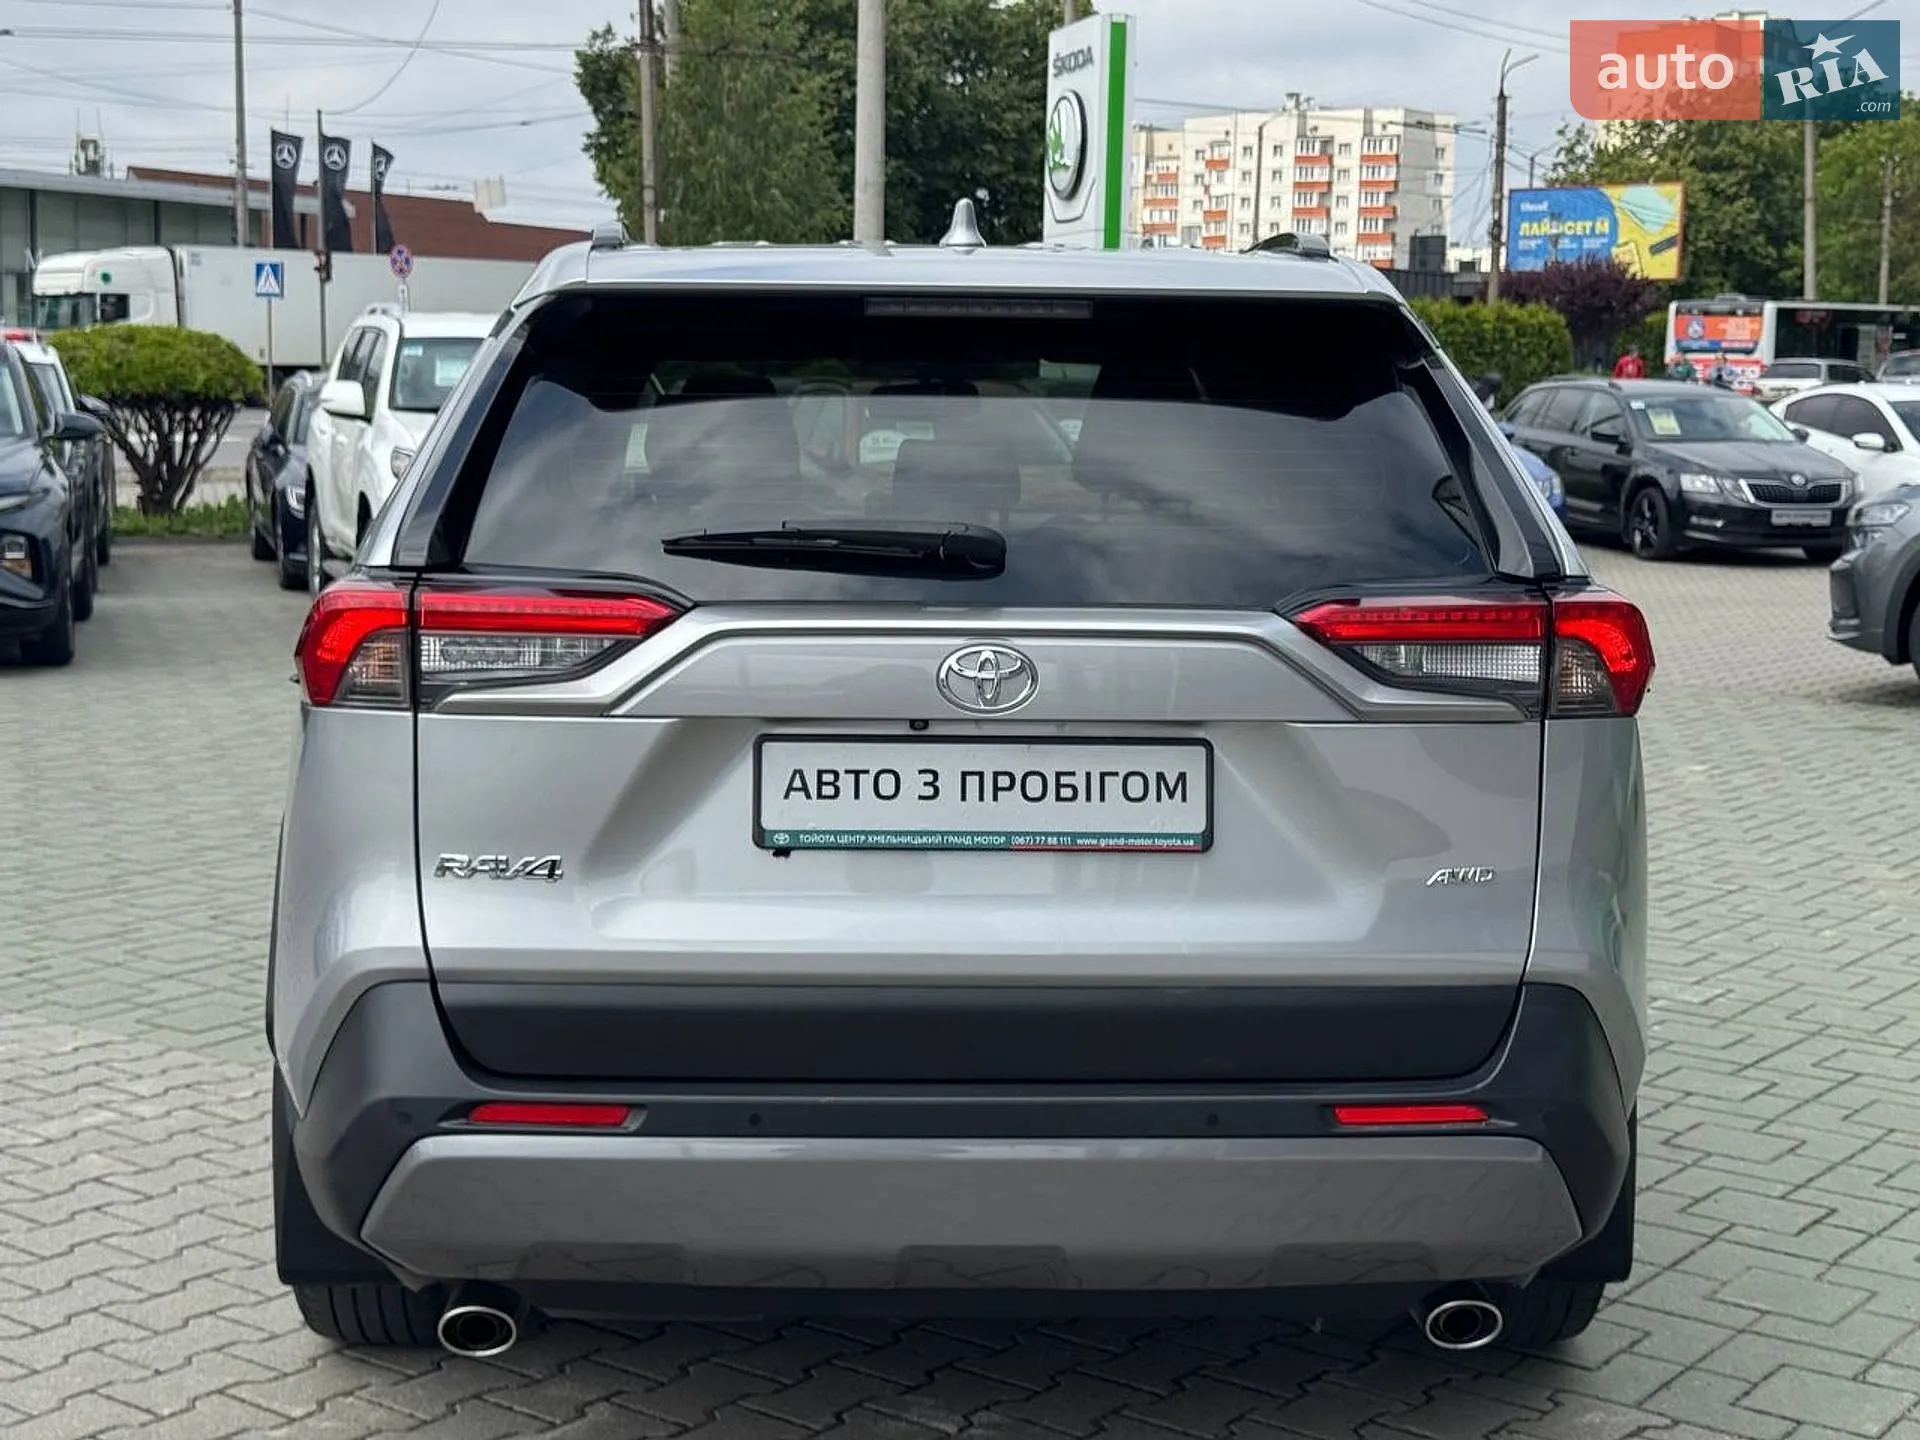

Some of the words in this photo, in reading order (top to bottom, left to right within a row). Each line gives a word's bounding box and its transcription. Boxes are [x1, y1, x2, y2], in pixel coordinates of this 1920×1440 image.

[783, 768, 902, 801] АВТО
[917, 769, 941, 801] З
[960, 770, 1189, 803] ПРОБІГОМ
[799, 832, 836, 844] ТОЙОТА
[837, 834, 866, 845] ЦЕНТР
[867, 834, 942, 846] ХМЕЛЬНИЦЬКИЙ
[944, 835, 972, 846] ГРАНД
[974, 835, 1006, 845] МОТОР
[1035, 836, 1045, 845] 77
[1059, 836, 1071, 846] 111
[434, 853, 564, 882] RAV4
[1426, 867, 1494, 886] AWD
